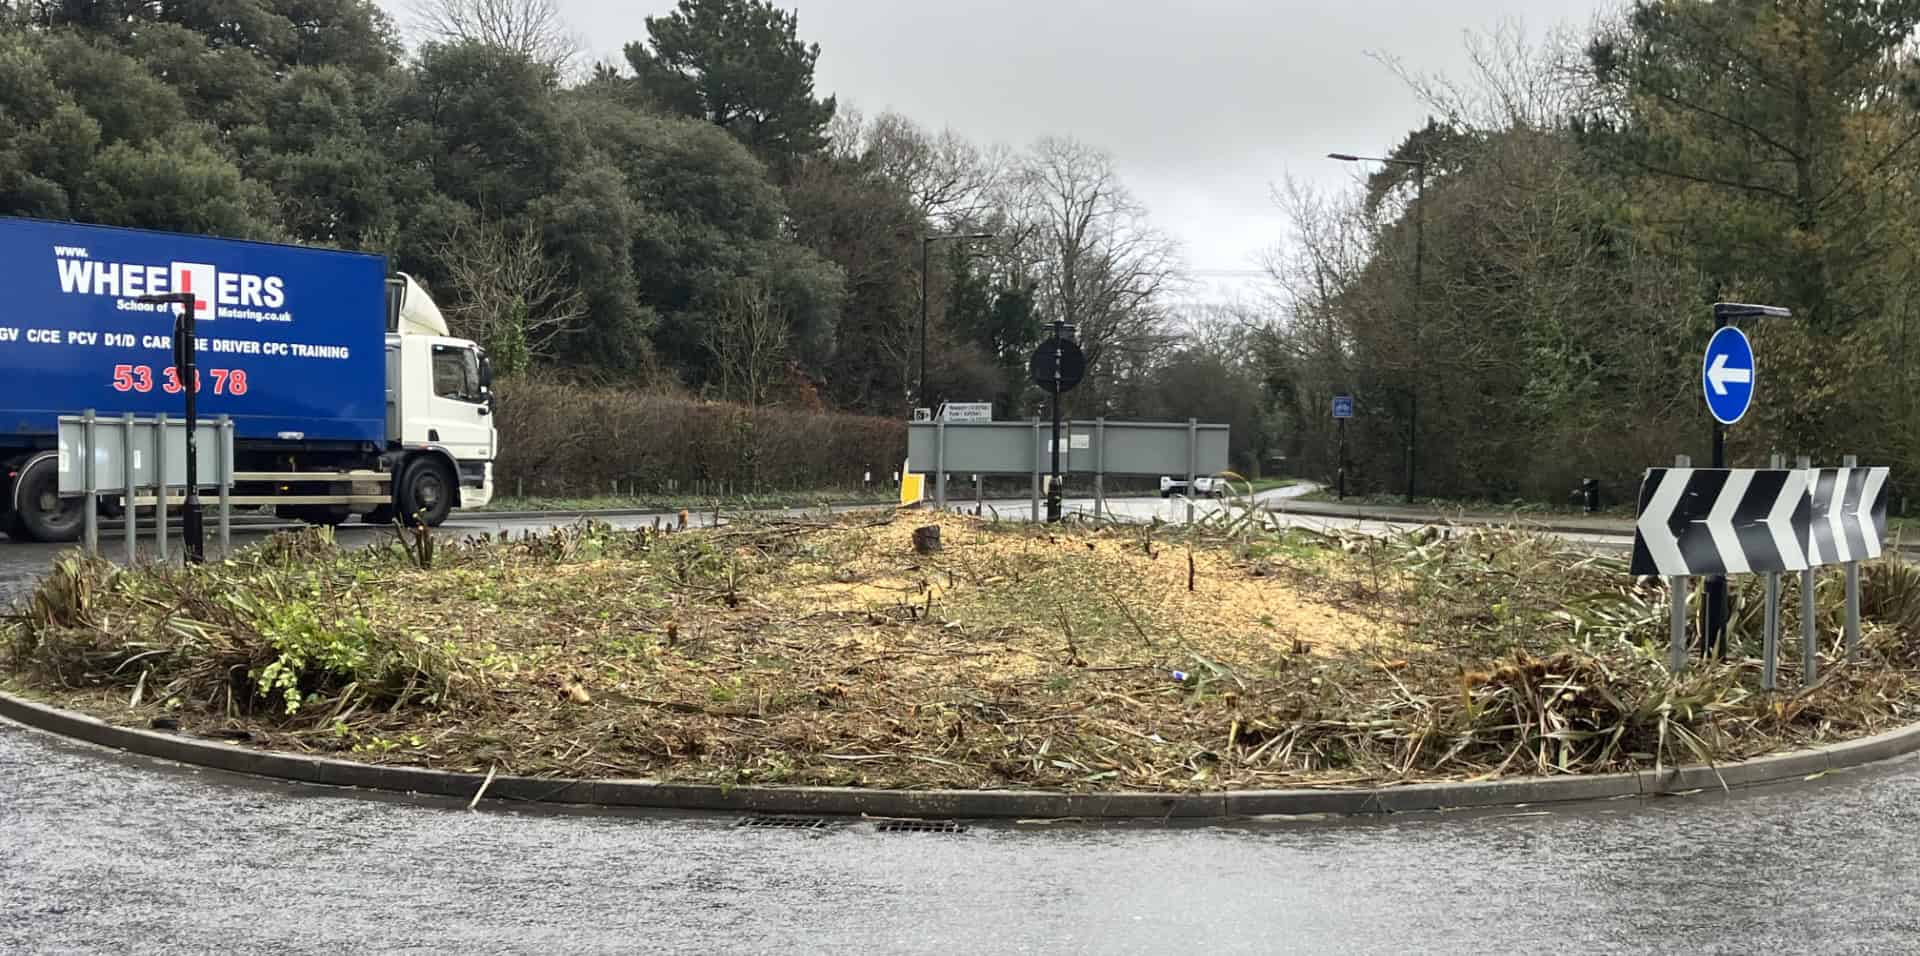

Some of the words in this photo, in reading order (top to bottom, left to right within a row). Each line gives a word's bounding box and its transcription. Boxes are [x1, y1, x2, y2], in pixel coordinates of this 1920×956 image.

[54, 246, 88, 257] www.
[157, 304, 169, 313] of
[219, 307, 291, 322] Motoring.co.uk
[27, 329, 61, 343] C/CE
[68, 331, 97, 345] PCV
[104, 333, 135, 347] D1/D
[142, 335, 171, 348] CAR
[213, 340, 260, 354] DRIVER
[263, 342, 288, 356] CPC
[291, 344, 348, 358] TRAINING
[114, 365, 153, 392] 53
[163, 367, 200, 393] 3
[210, 369, 247, 395] 78
